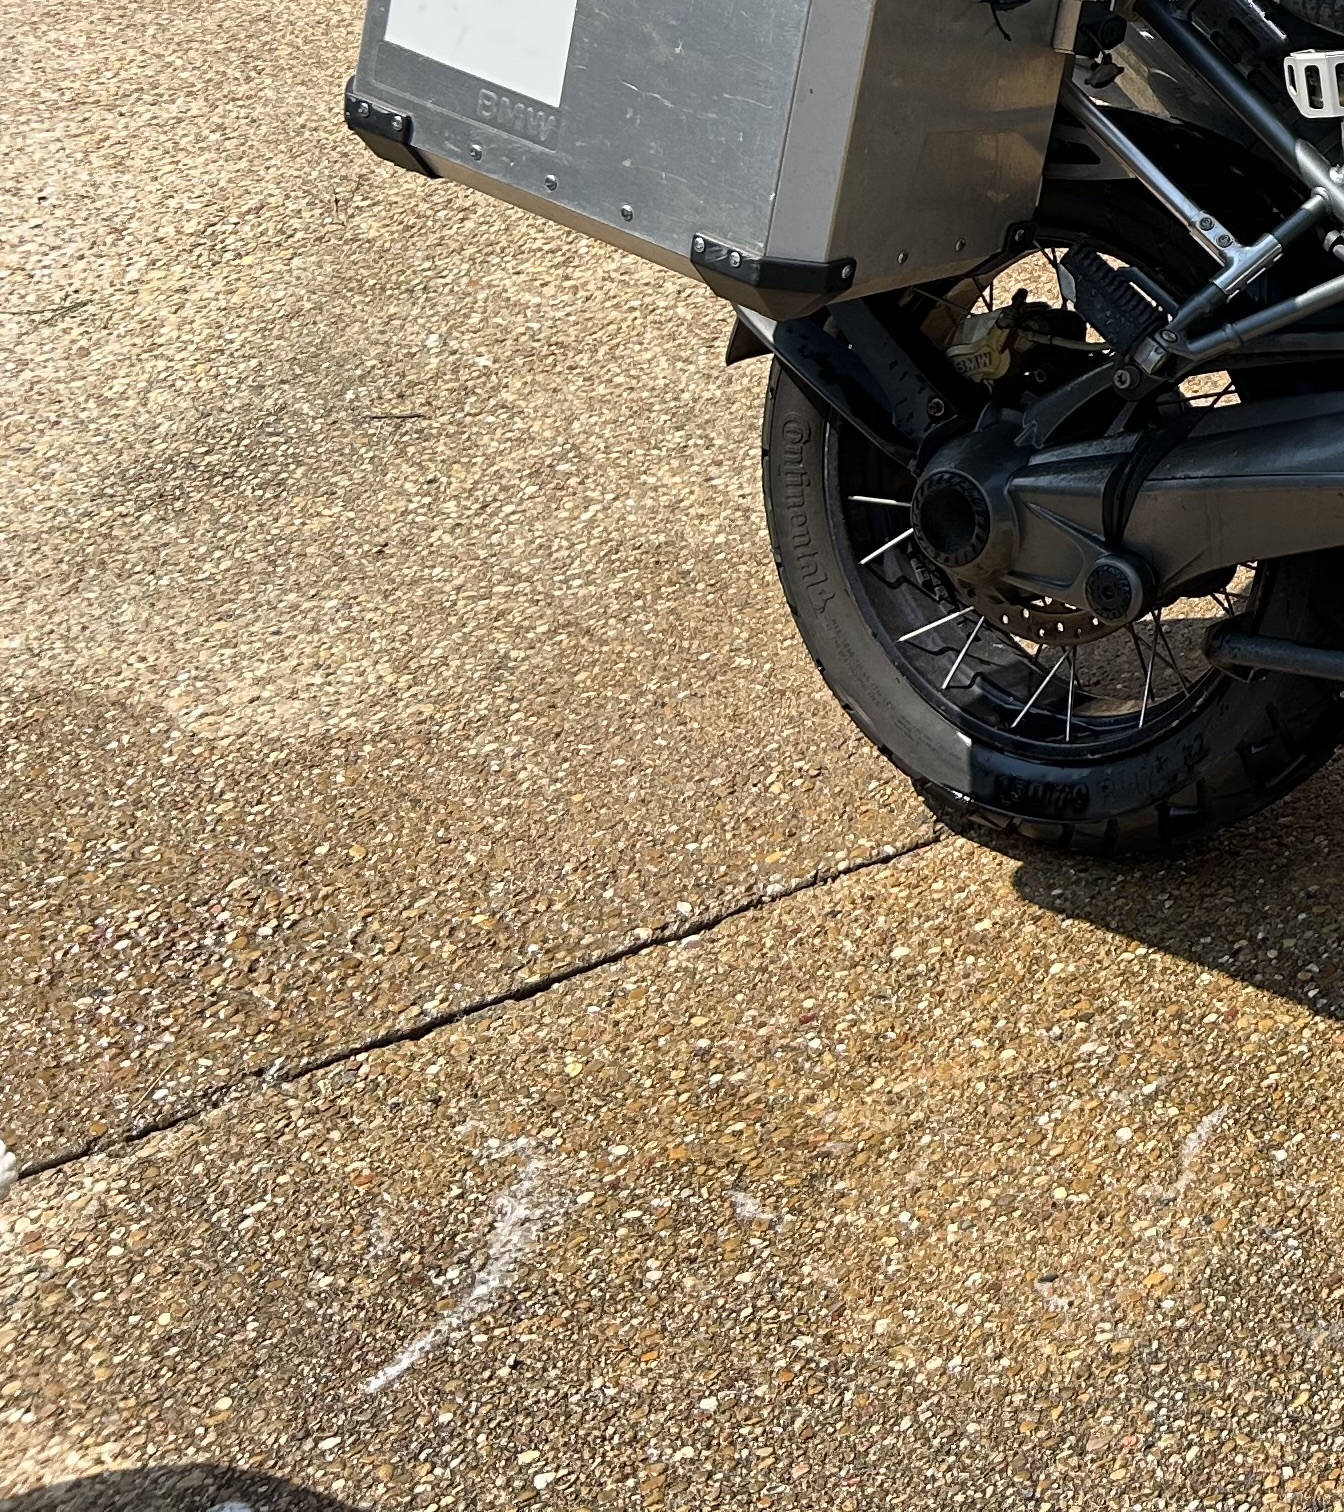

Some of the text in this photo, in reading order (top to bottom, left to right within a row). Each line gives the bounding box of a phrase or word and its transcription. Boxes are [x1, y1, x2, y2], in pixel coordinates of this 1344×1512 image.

[477, 88, 557, 142] BMW
[954, 351, 992, 374] BMW
[781, 412, 828, 590] Continental
